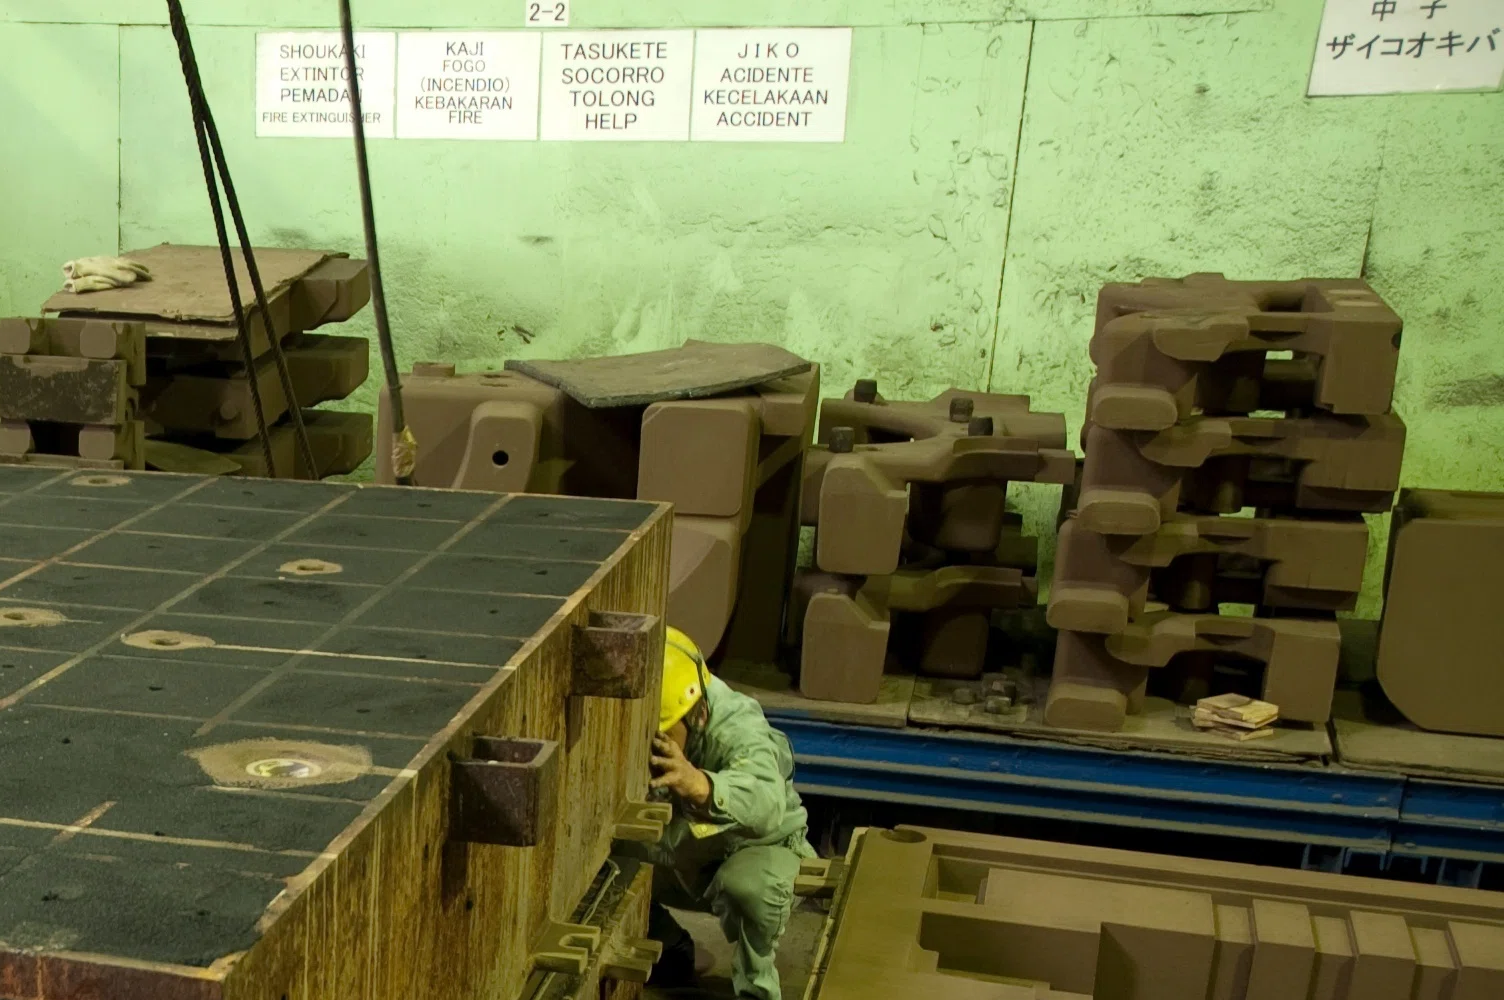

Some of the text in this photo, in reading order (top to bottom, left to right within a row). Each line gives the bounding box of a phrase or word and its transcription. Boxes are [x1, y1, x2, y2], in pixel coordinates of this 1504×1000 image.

[529, 2, 565, 21] 2-2
[446, 41, 484, 56] KAJI
[560, 42, 668, 60] TASUKETE
[1326, 27, 1501, 60] ザイコオキバ
[442, 59, 486, 73] FOGO
[561, 67, 665, 84] SOCORRO
[720, 67, 814, 83] ACIDENTE
[420, 77, 510, 93] (INCENDIO)
[415, 96, 513, 110] KEBAKARAN
[569, 90, 655, 107] TOLONG
[704, 89, 829, 105] KECELAKAAN
[262, 112, 288, 123] FIRE
[448, 110, 483, 124] FIRE
[585, 113, 638, 130] HELP
[716, 111, 813, 127] ACCIDENT
